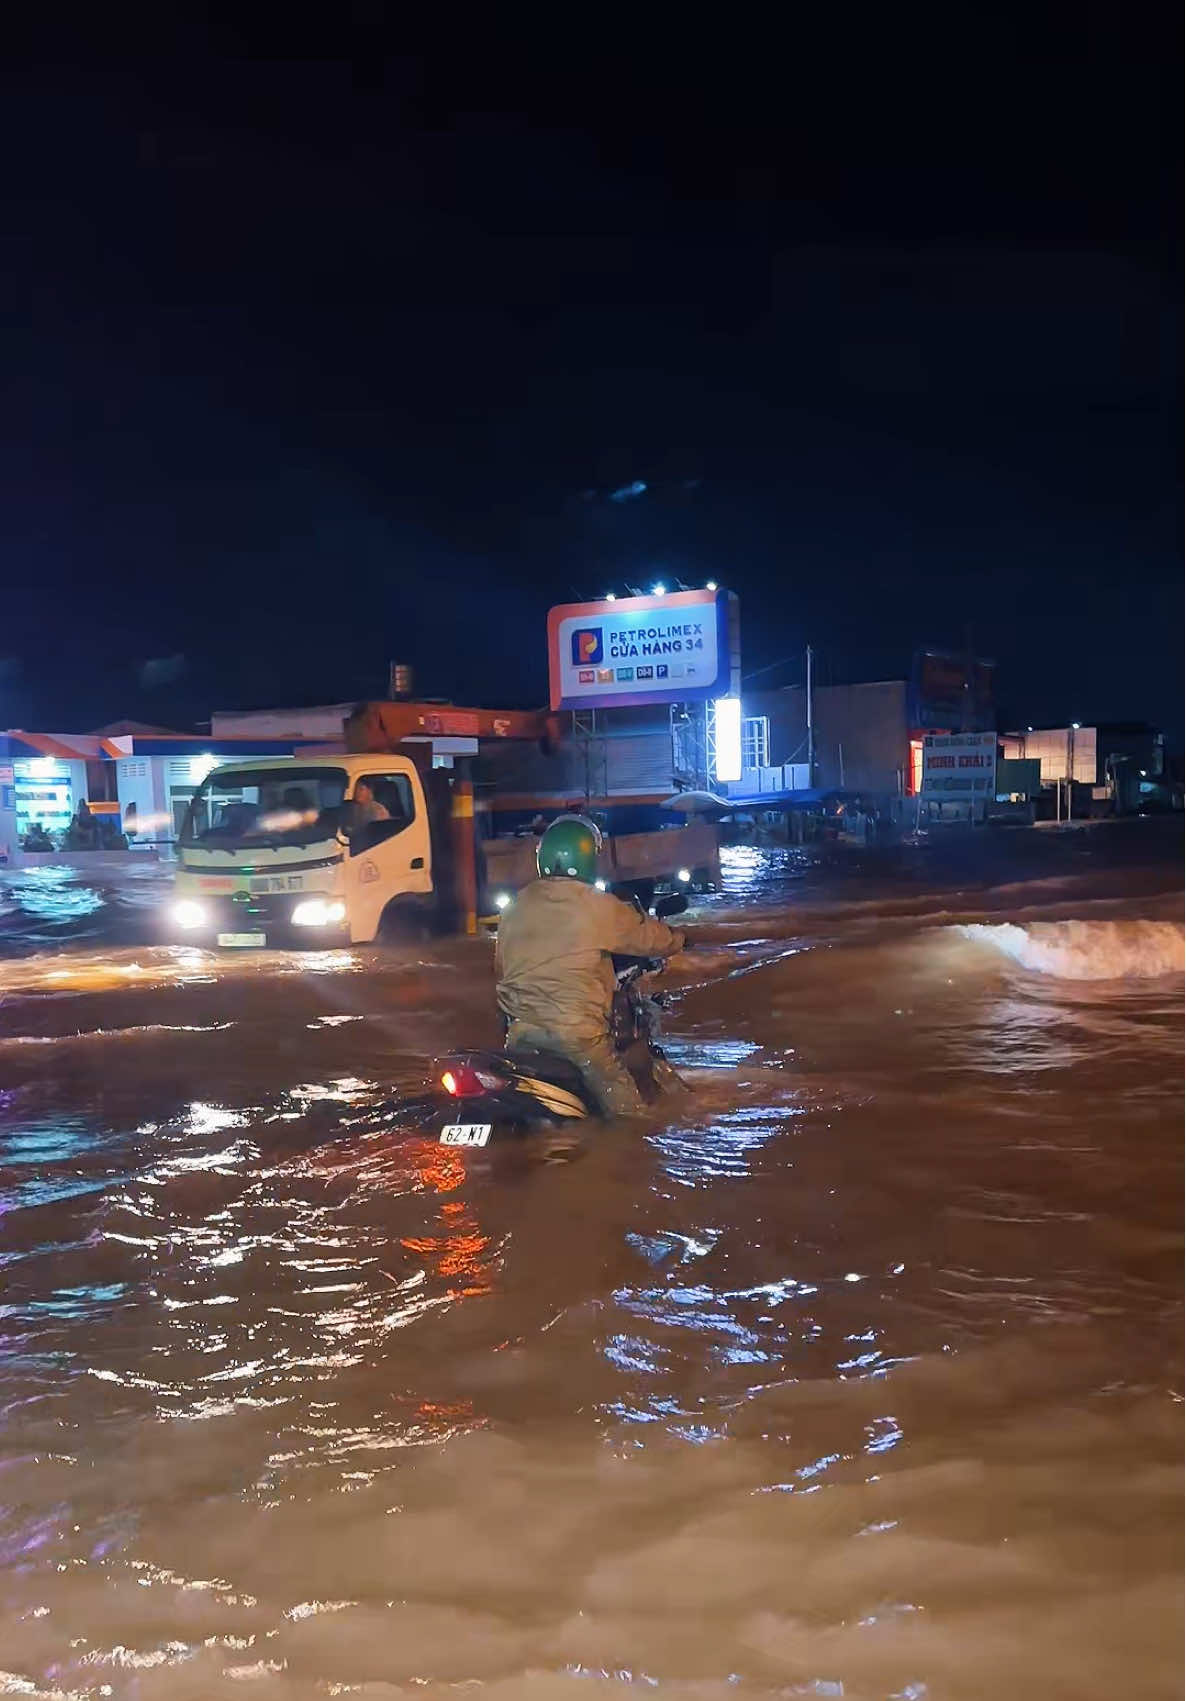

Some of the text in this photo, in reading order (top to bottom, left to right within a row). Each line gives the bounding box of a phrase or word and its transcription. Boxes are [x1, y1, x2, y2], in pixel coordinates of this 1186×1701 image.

[610, 624, 702, 643] PETROLIMEX
[685, 638, 703, 650] 34
[446, 1127, 484, 1142] 62-N1
